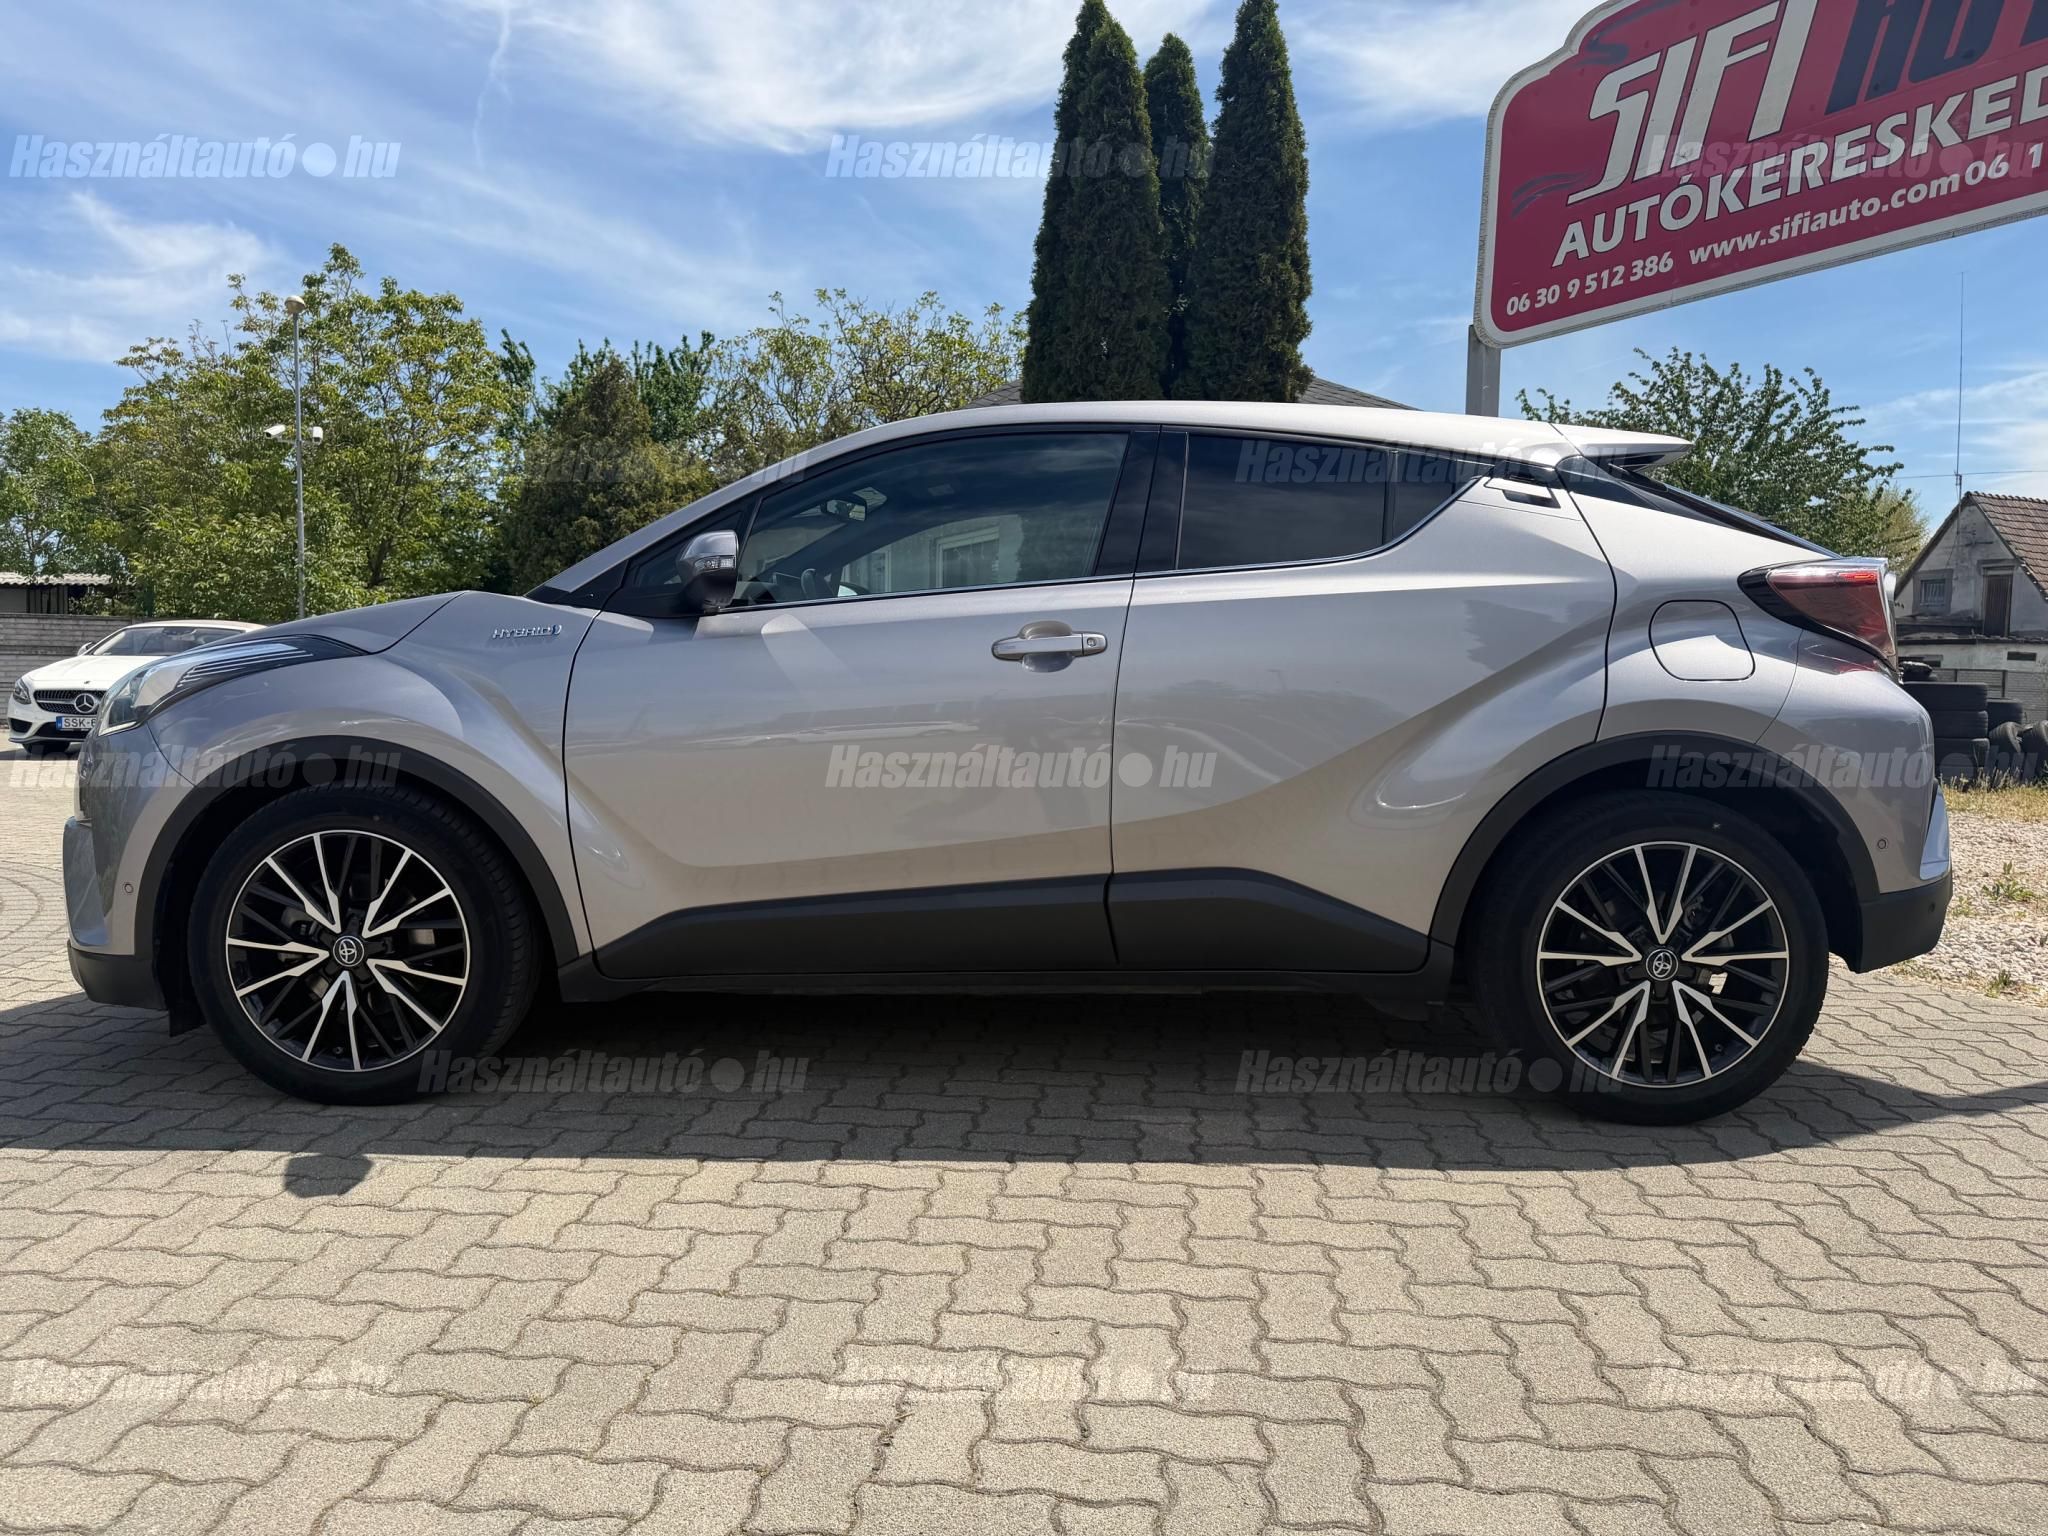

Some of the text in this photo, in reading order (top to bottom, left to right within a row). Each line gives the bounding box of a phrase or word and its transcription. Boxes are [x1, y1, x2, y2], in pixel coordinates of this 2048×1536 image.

[1506, 293, 1531, 316] 06
[1534, 284, 1561, 309] 30
[1566, 278, 1581, 299] 9
[1584, 264, 1626, 295] 512
[1629, 250, 1675, 282] 386
[1688, 172, 1961, 266] www.sifiauto.com
[1964, 152, 2010, 187] 06
[492, 626, 553, 639] HYBRID
